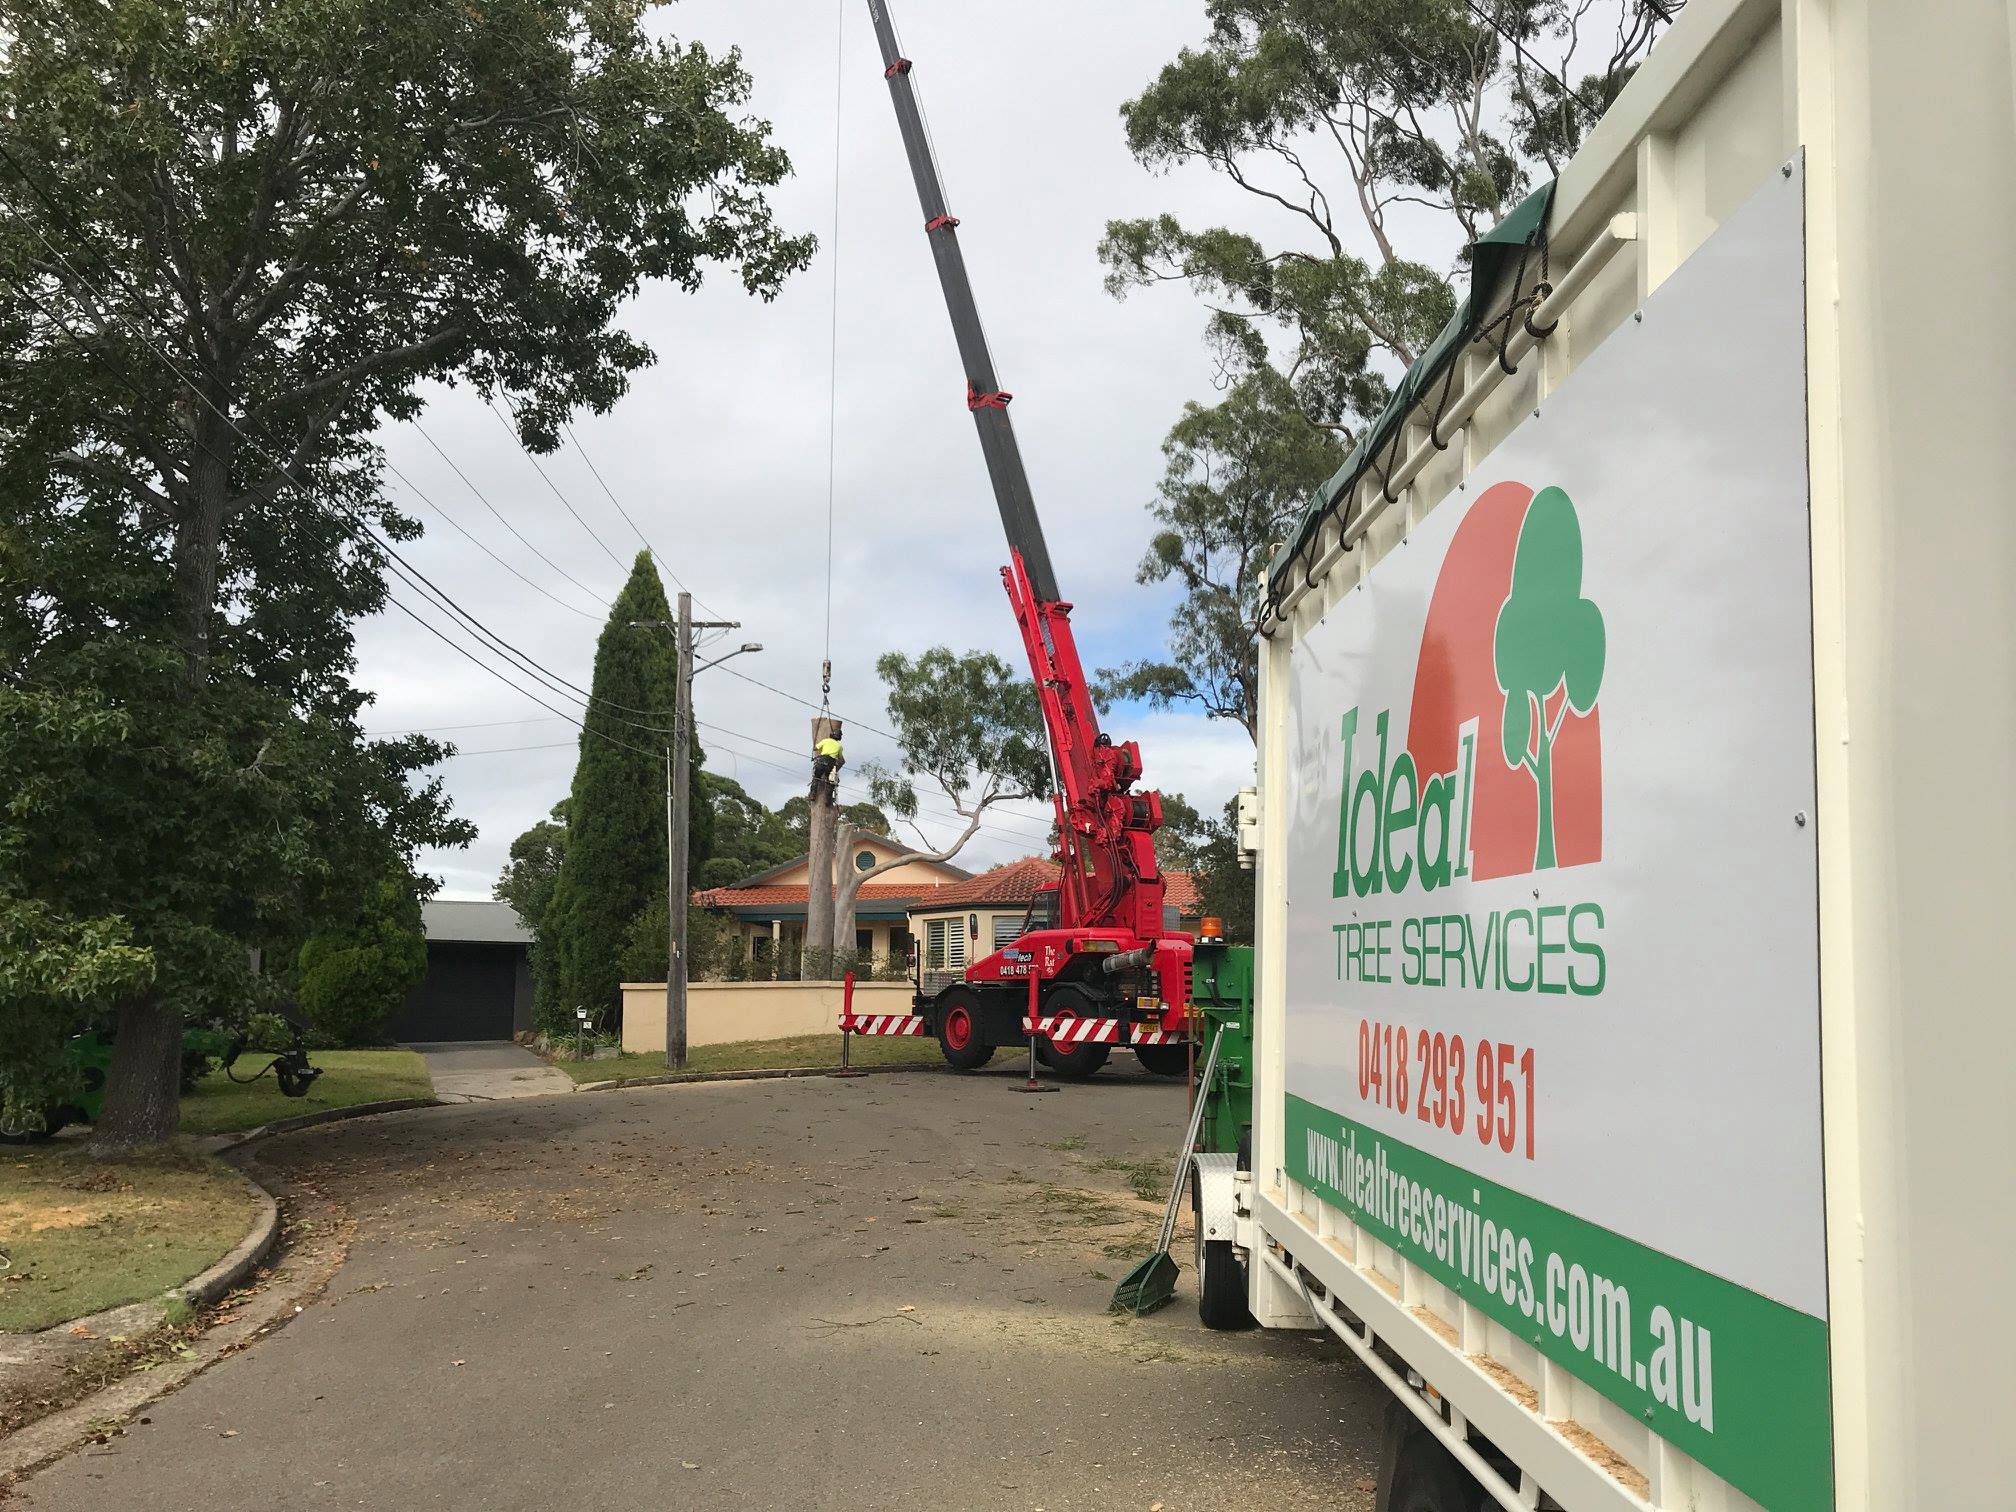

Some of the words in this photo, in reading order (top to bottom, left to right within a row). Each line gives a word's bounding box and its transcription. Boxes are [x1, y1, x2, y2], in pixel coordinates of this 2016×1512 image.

[1333, 706, 1475, 899] Ideal
[1333, 920, 1392, 984] TREE
[1402, 902, 1606, 997] SERVICES
[1359, 1019, 1409, 1114] 0418
[1416, 1029, 1465, 1136] 293
[1476, 1039, 1535, 1161] 951
[1307, 1127, 1714, 1434] www.idealtreeservices.com.au
